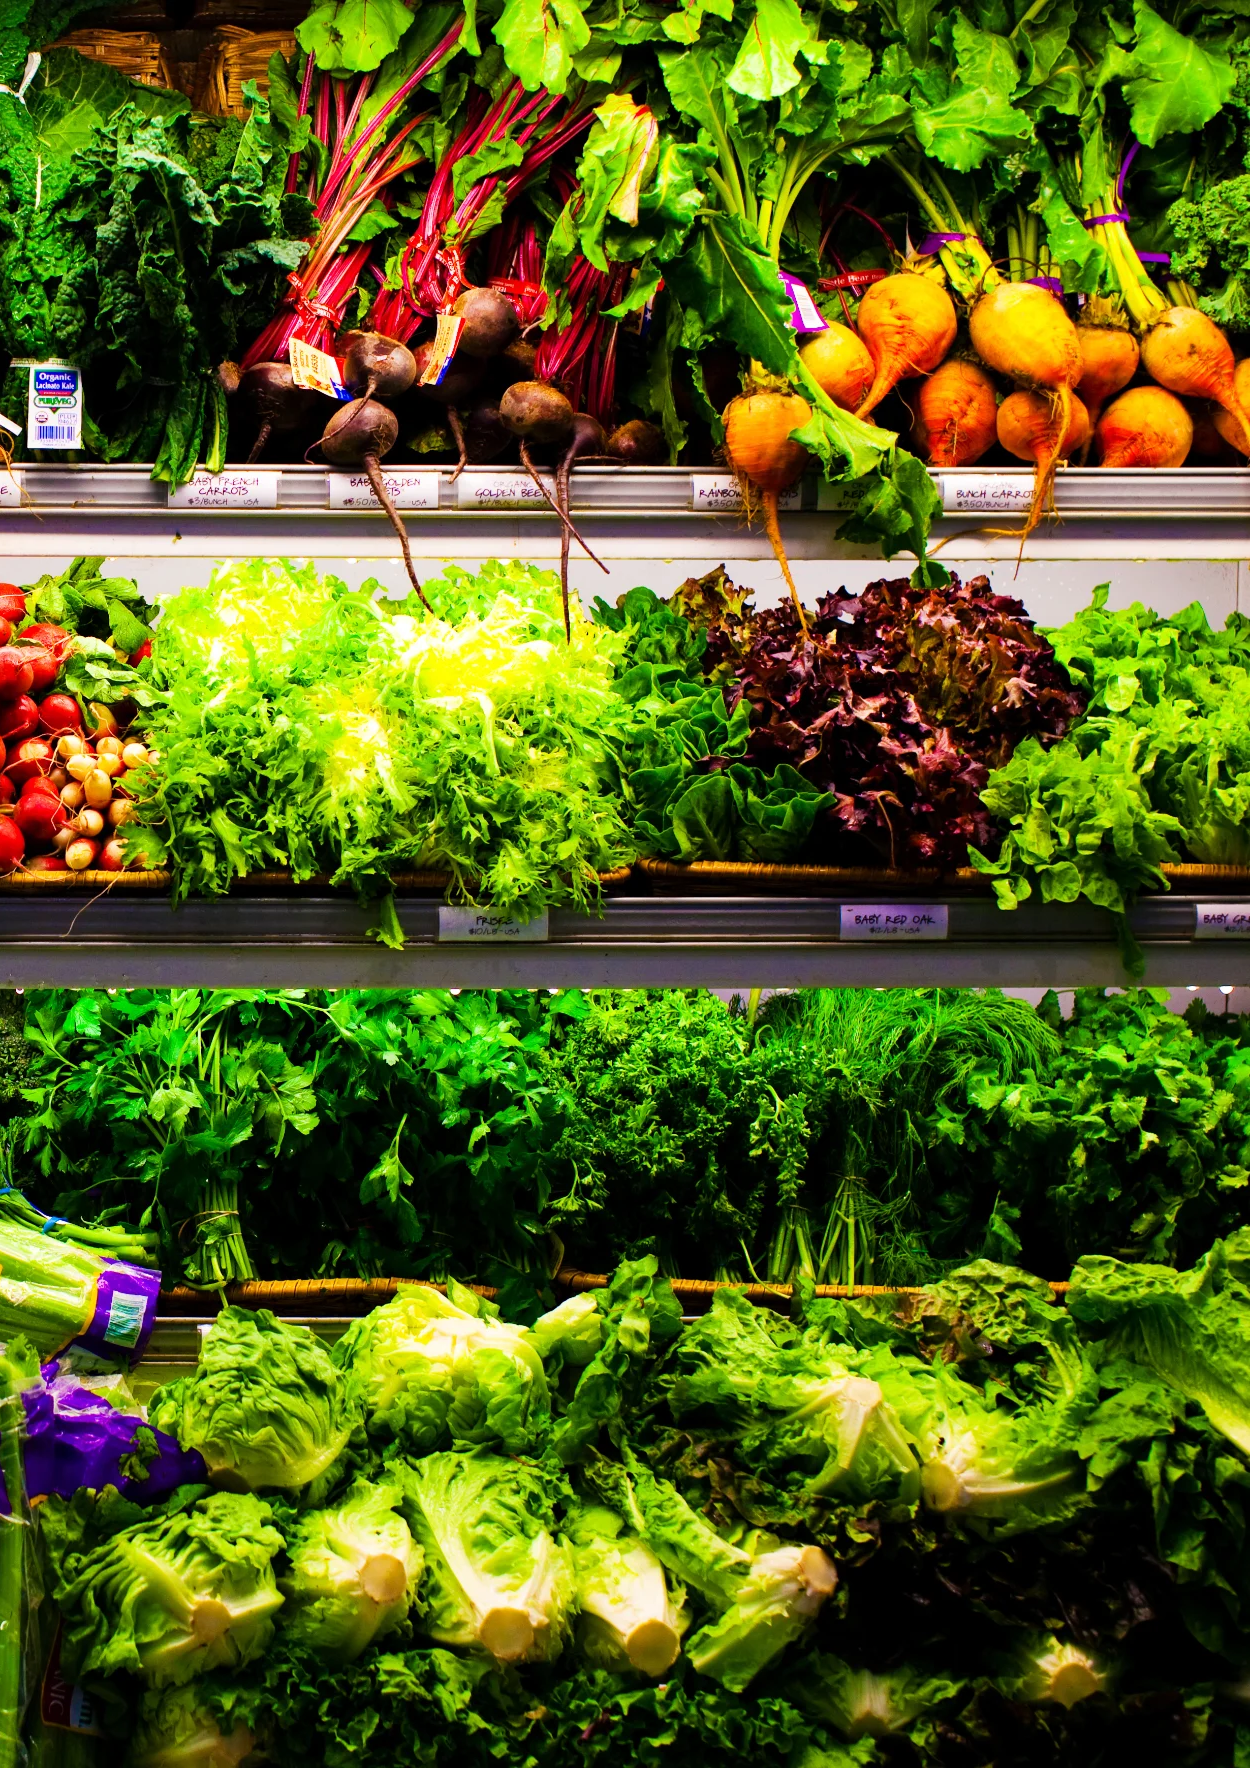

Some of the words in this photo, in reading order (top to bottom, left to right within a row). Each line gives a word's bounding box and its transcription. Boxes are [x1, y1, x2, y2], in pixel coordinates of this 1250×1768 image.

[847, 275, 869, 283] Bear
[39, 372, 72, 382] Organic
[36, 381, 61, 390] Lacinato
[61, 382, 75, 390] Kale
[219, 476, 259, 486] FRENCH
[350, 477, 371, 487] BAB
[199, 487, 249, 496] CARROTS
[370, 487, 401, 497] BETS
[475, 488, 516, 498] GOLDEN
[699, 489, 742, 499] RAINBOW
[956, 490, 987, 499] BUNCH
[991, 489, 1035, 499] CARROT
[188, 497, 228, 505] $3/BUNCH
[855, 913, 882, 924] BABY
[885, 914, 907, 925] RED
[912, 915, 937, 925] OAK
[1203, 913, 1229, 924] BABY
